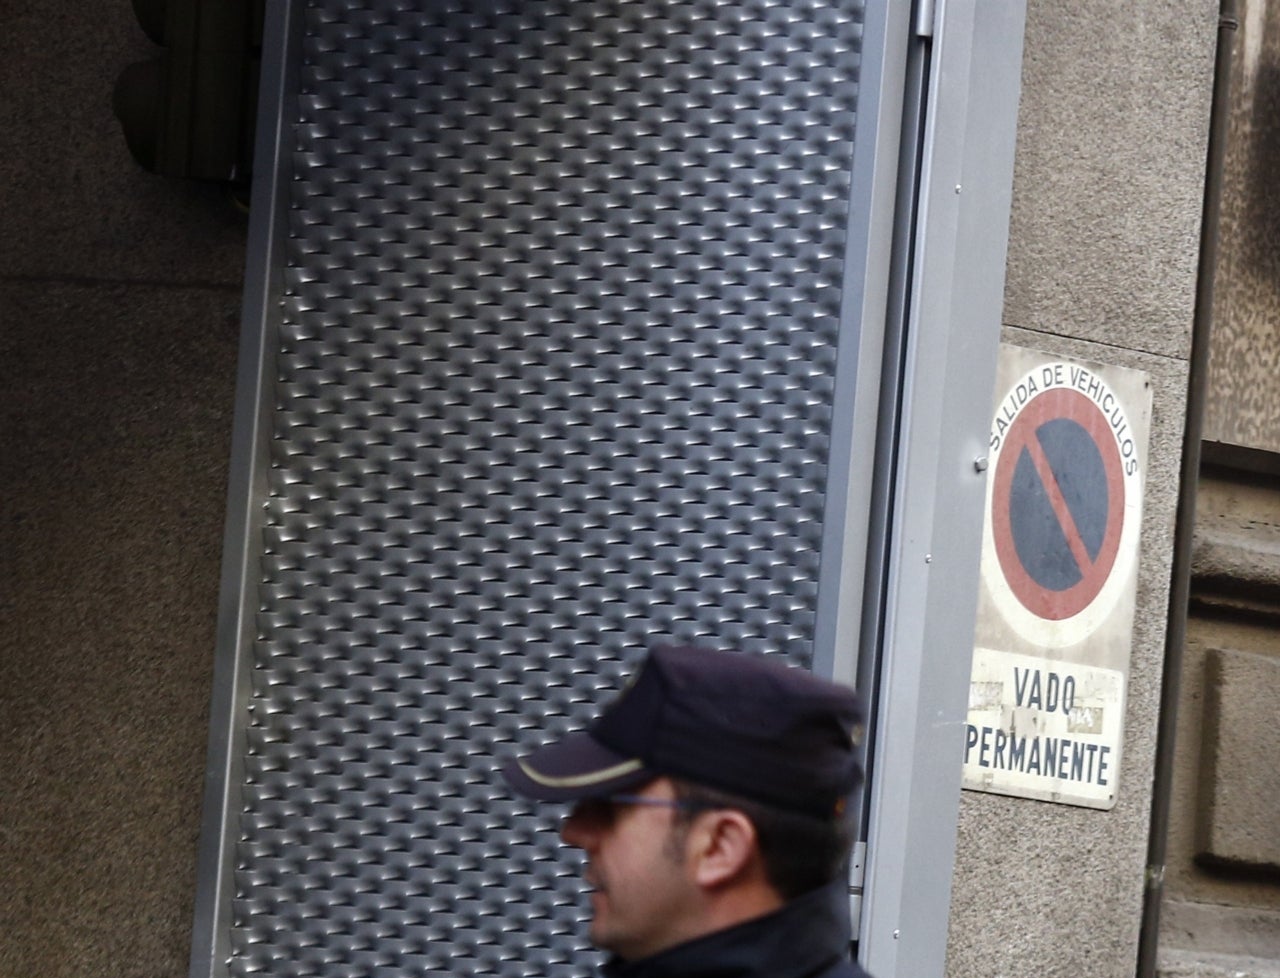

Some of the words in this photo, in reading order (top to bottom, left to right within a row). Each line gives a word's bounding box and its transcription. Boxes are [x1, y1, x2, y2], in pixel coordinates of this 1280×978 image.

[989, 376, 1039, 451] SALIDA
[1042, 364, 1065, 388] DE
[1070, 366, 1138, 477] VEHICULOS
[1014, 667, 1075, 715] VADO
[964, 724, 1111, 786] PERMANENTE
